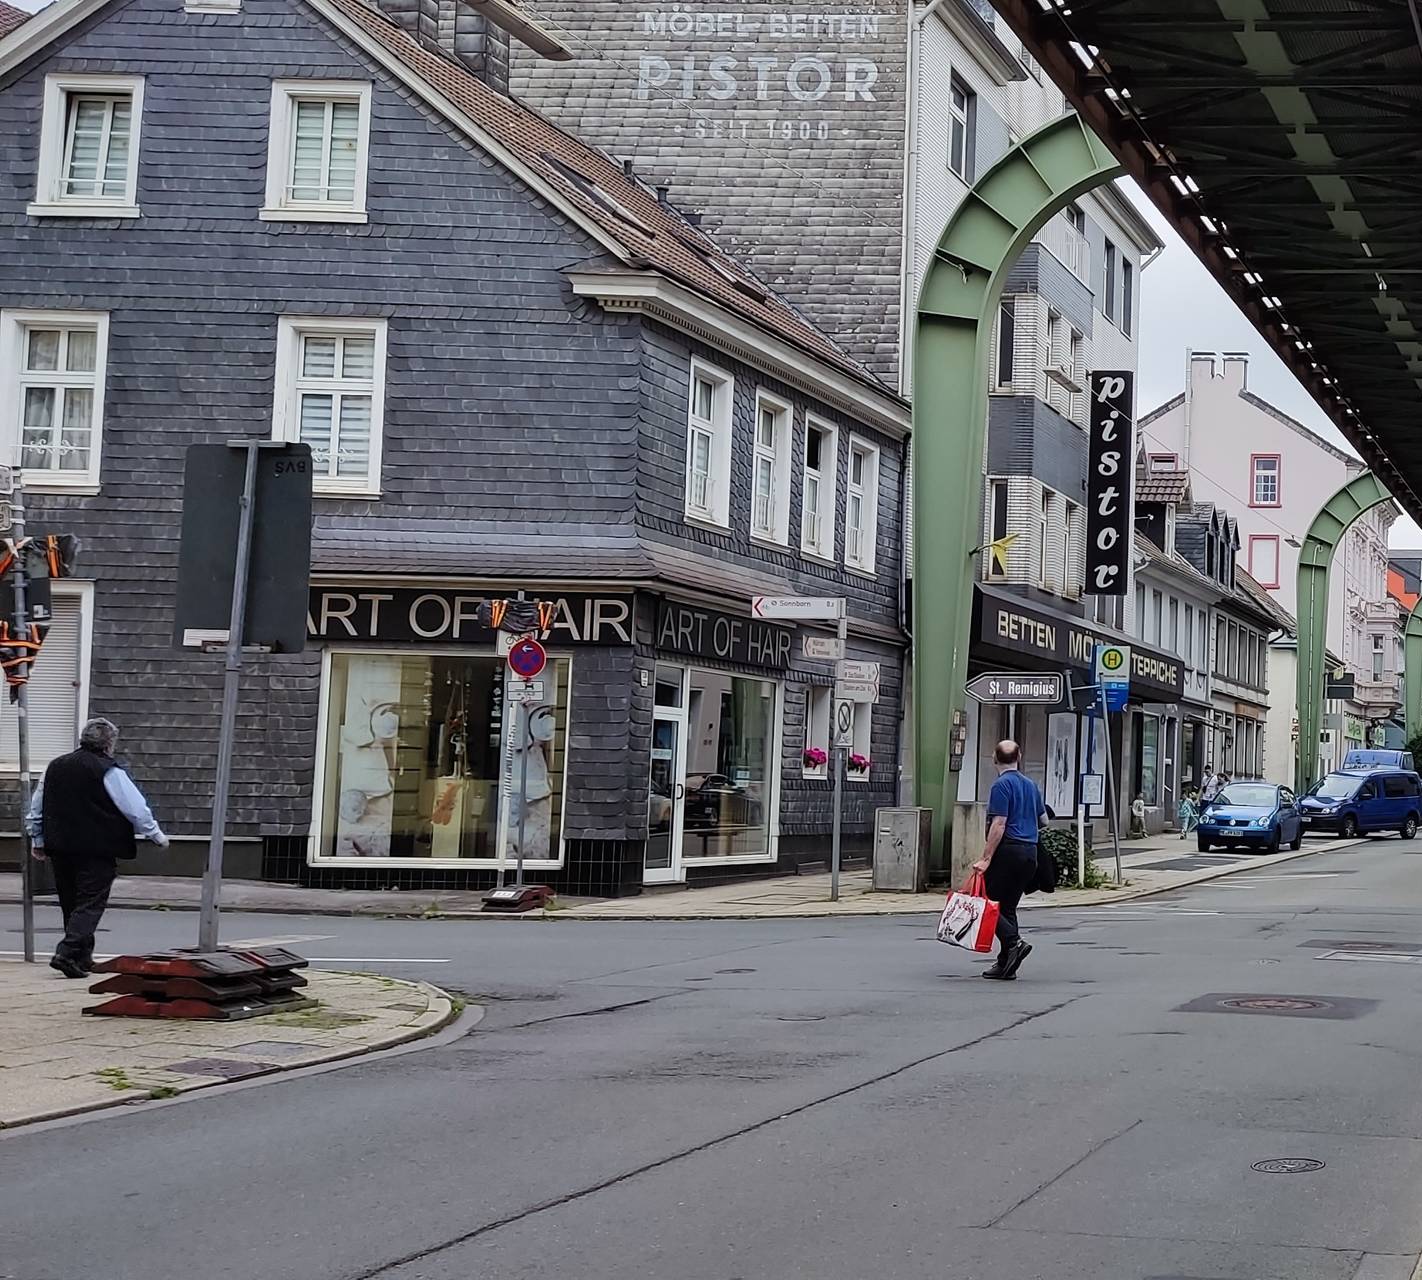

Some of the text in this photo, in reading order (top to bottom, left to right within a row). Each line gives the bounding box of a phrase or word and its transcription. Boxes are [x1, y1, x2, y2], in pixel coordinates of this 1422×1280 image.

[637, 56, 877, 101] PISTOR
[695, 119, 829, 140] SEIT 1900
[1094, 376, 1126, 588] pistor
[409, 594, 485, 639] OF
[534, 598, 631, 642] AIR
[659, 607, 792, 668] ART OF HAIR
[997, 610, 1056, 651] BETTEN
[1131, 652, 1177, 685] TEPPICHE
[1108, 653, 1118, 666] H
[989, 681, 1055, 697] St. Remigius
